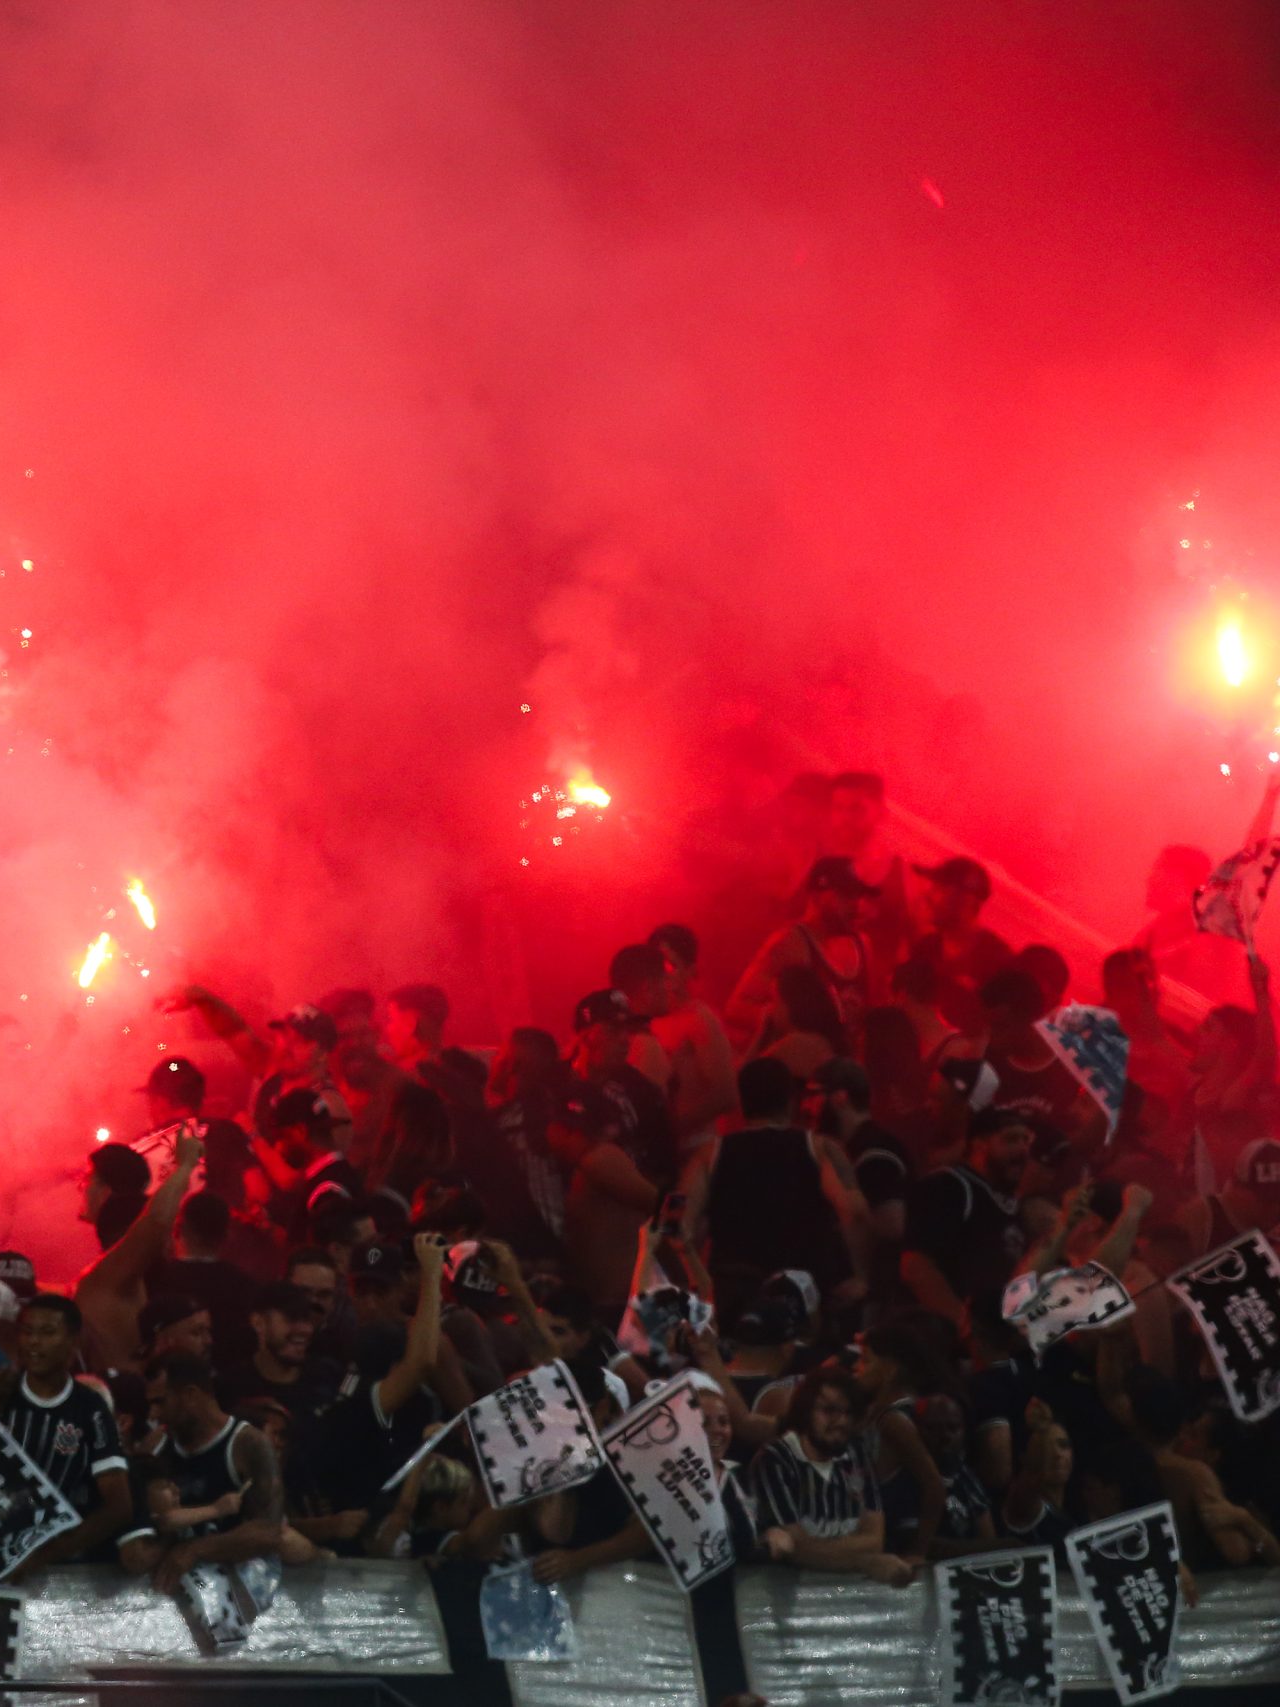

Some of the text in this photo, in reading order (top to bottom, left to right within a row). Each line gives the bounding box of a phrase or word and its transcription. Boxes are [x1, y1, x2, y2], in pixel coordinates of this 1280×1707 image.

[656, 1474, 701, 1523] LUTAR
[677, 1458, 715, 1505] PARA
[1116, 1584, 1152, 1645] LUTAR
[1136, 1576, 1167, 1632] PARA
